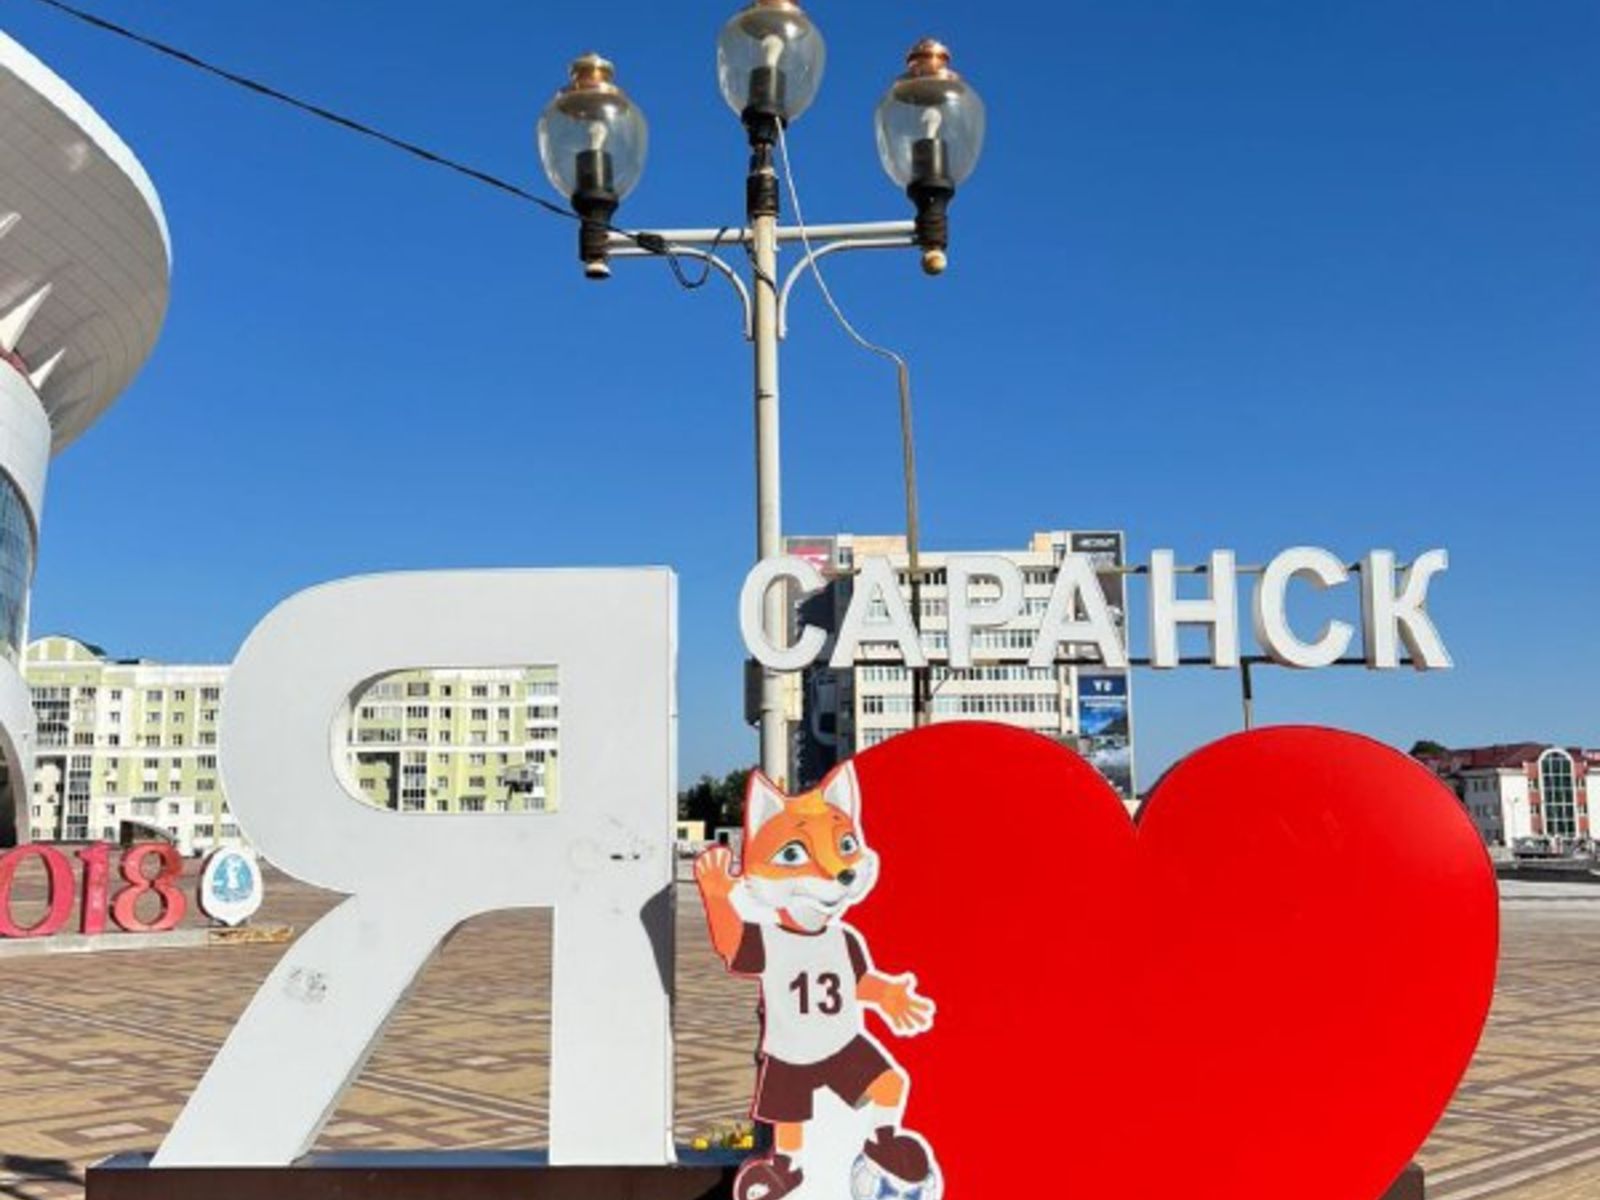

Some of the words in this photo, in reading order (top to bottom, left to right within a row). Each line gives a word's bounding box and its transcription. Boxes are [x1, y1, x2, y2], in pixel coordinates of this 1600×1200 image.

[740, 546, 1453, 671] САРАНСК
[150, 566, 678, 1167] Я
[789, 972, 843, 1015] 13
